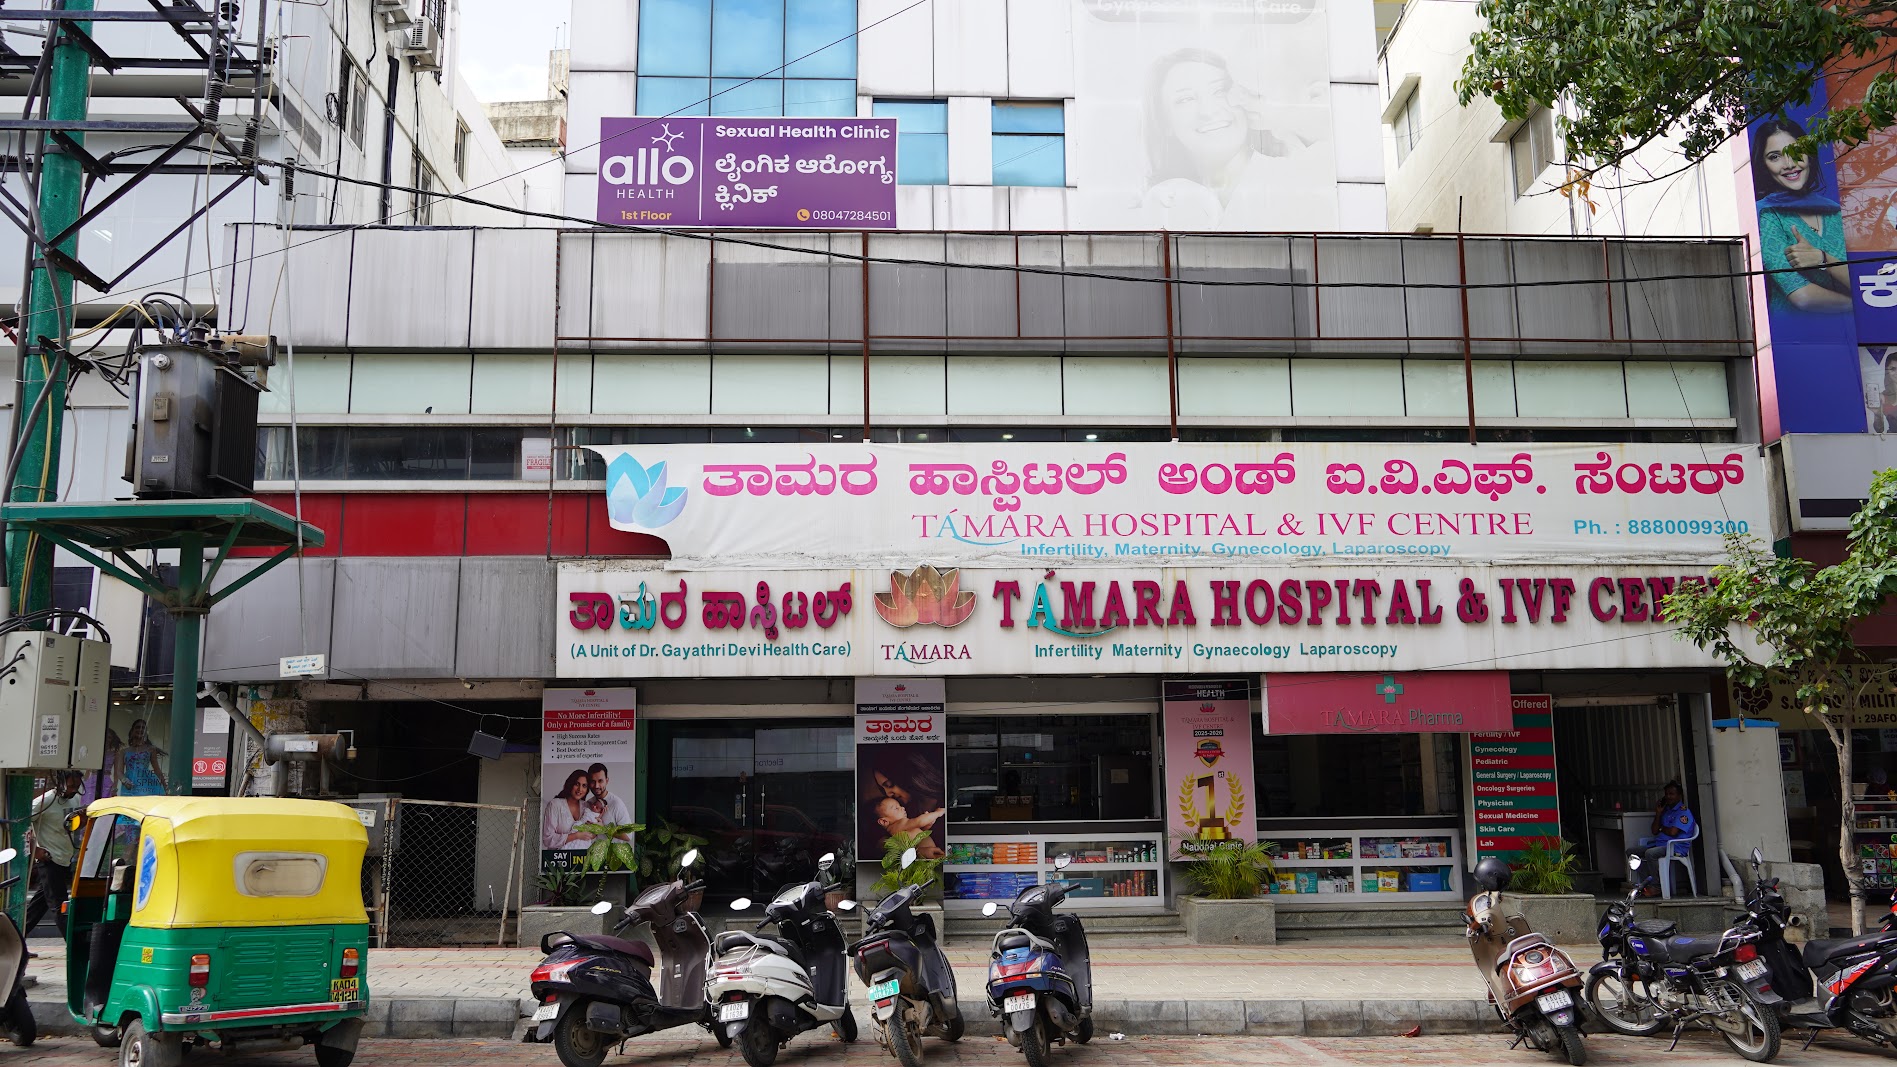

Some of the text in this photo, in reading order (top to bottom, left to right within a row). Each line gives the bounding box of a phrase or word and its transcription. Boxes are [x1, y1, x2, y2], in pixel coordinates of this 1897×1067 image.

[715, 125, 890, 139] Sexual Health Clinic
[602, 148, 694, 185] allo
[715, 153, 893, 185] ಲೈಂಗಿಕ ಆರೋಗ್ಯ
[617, 189, 674, 199] HEALTH
[714, 184, 778, 211] ಕ್ಲಿನಿಕ್
[621, 211, 672, 220] 1st Floor
[812, 210, 891, 221] 08047284501
[703, 452, 1745, 511] ತಾಮರ ಹಾಸ್ಪಿಟಲ್ ಅಂಡ್ ಐ.ವಿ.ಎಫ್. ಸೆಂಟರ್
[1084, 511, 1266, 538] HOSPITAL
[1277, 512, 1304, 537] &
[1317, 512, 1377, 537] IVF
[1387, 511, 1534, 536] CENTRE
[1573, 519, 1608, 535] Ph.
[1627, 518, 1749, 536] 8880099300
[1020, 541, 1452, 559] Infertility, Maternity, Gynecology, Laparoscopy
[569, 577, 689, 631] ತಾಮರ
[1210, 579, 1443, 626] HOSPITAL
[1456, 577, 1489, 624] &
[1499, 577, 1576, 624] IVF
[590, 643, 618, 658] Unit
[622, 643, 636, 657] of
[639, 643, 659, 656] Dr.
[661, 643, 726, 659] Gayathri
[728, 643, 761, 656] Devi
[763, 642, 809, 656] Health
[812, 641, 852, 657] Care)
[1035, 643, 1398, 660] Infertility Maternity Gynaecology Laparoscopy
[1513, 699, 1548, 709] Offered
[587, 711, 621, 719] Infertility!
[1409, 708, 1463, 725] Pharma
[547, 721, 562, 729] Only
[597, 720, 605, 728] of
[610, 720, 632, 728] family
[866, 715, 932, 733] ತಾಮರ
[1497, 771, 1516, 779] Surgery
[1520, 771, 1551, 779] Laparoscopy
[553, 852, 568, 860] SAY
[333, 979, 357, 990] KA04
